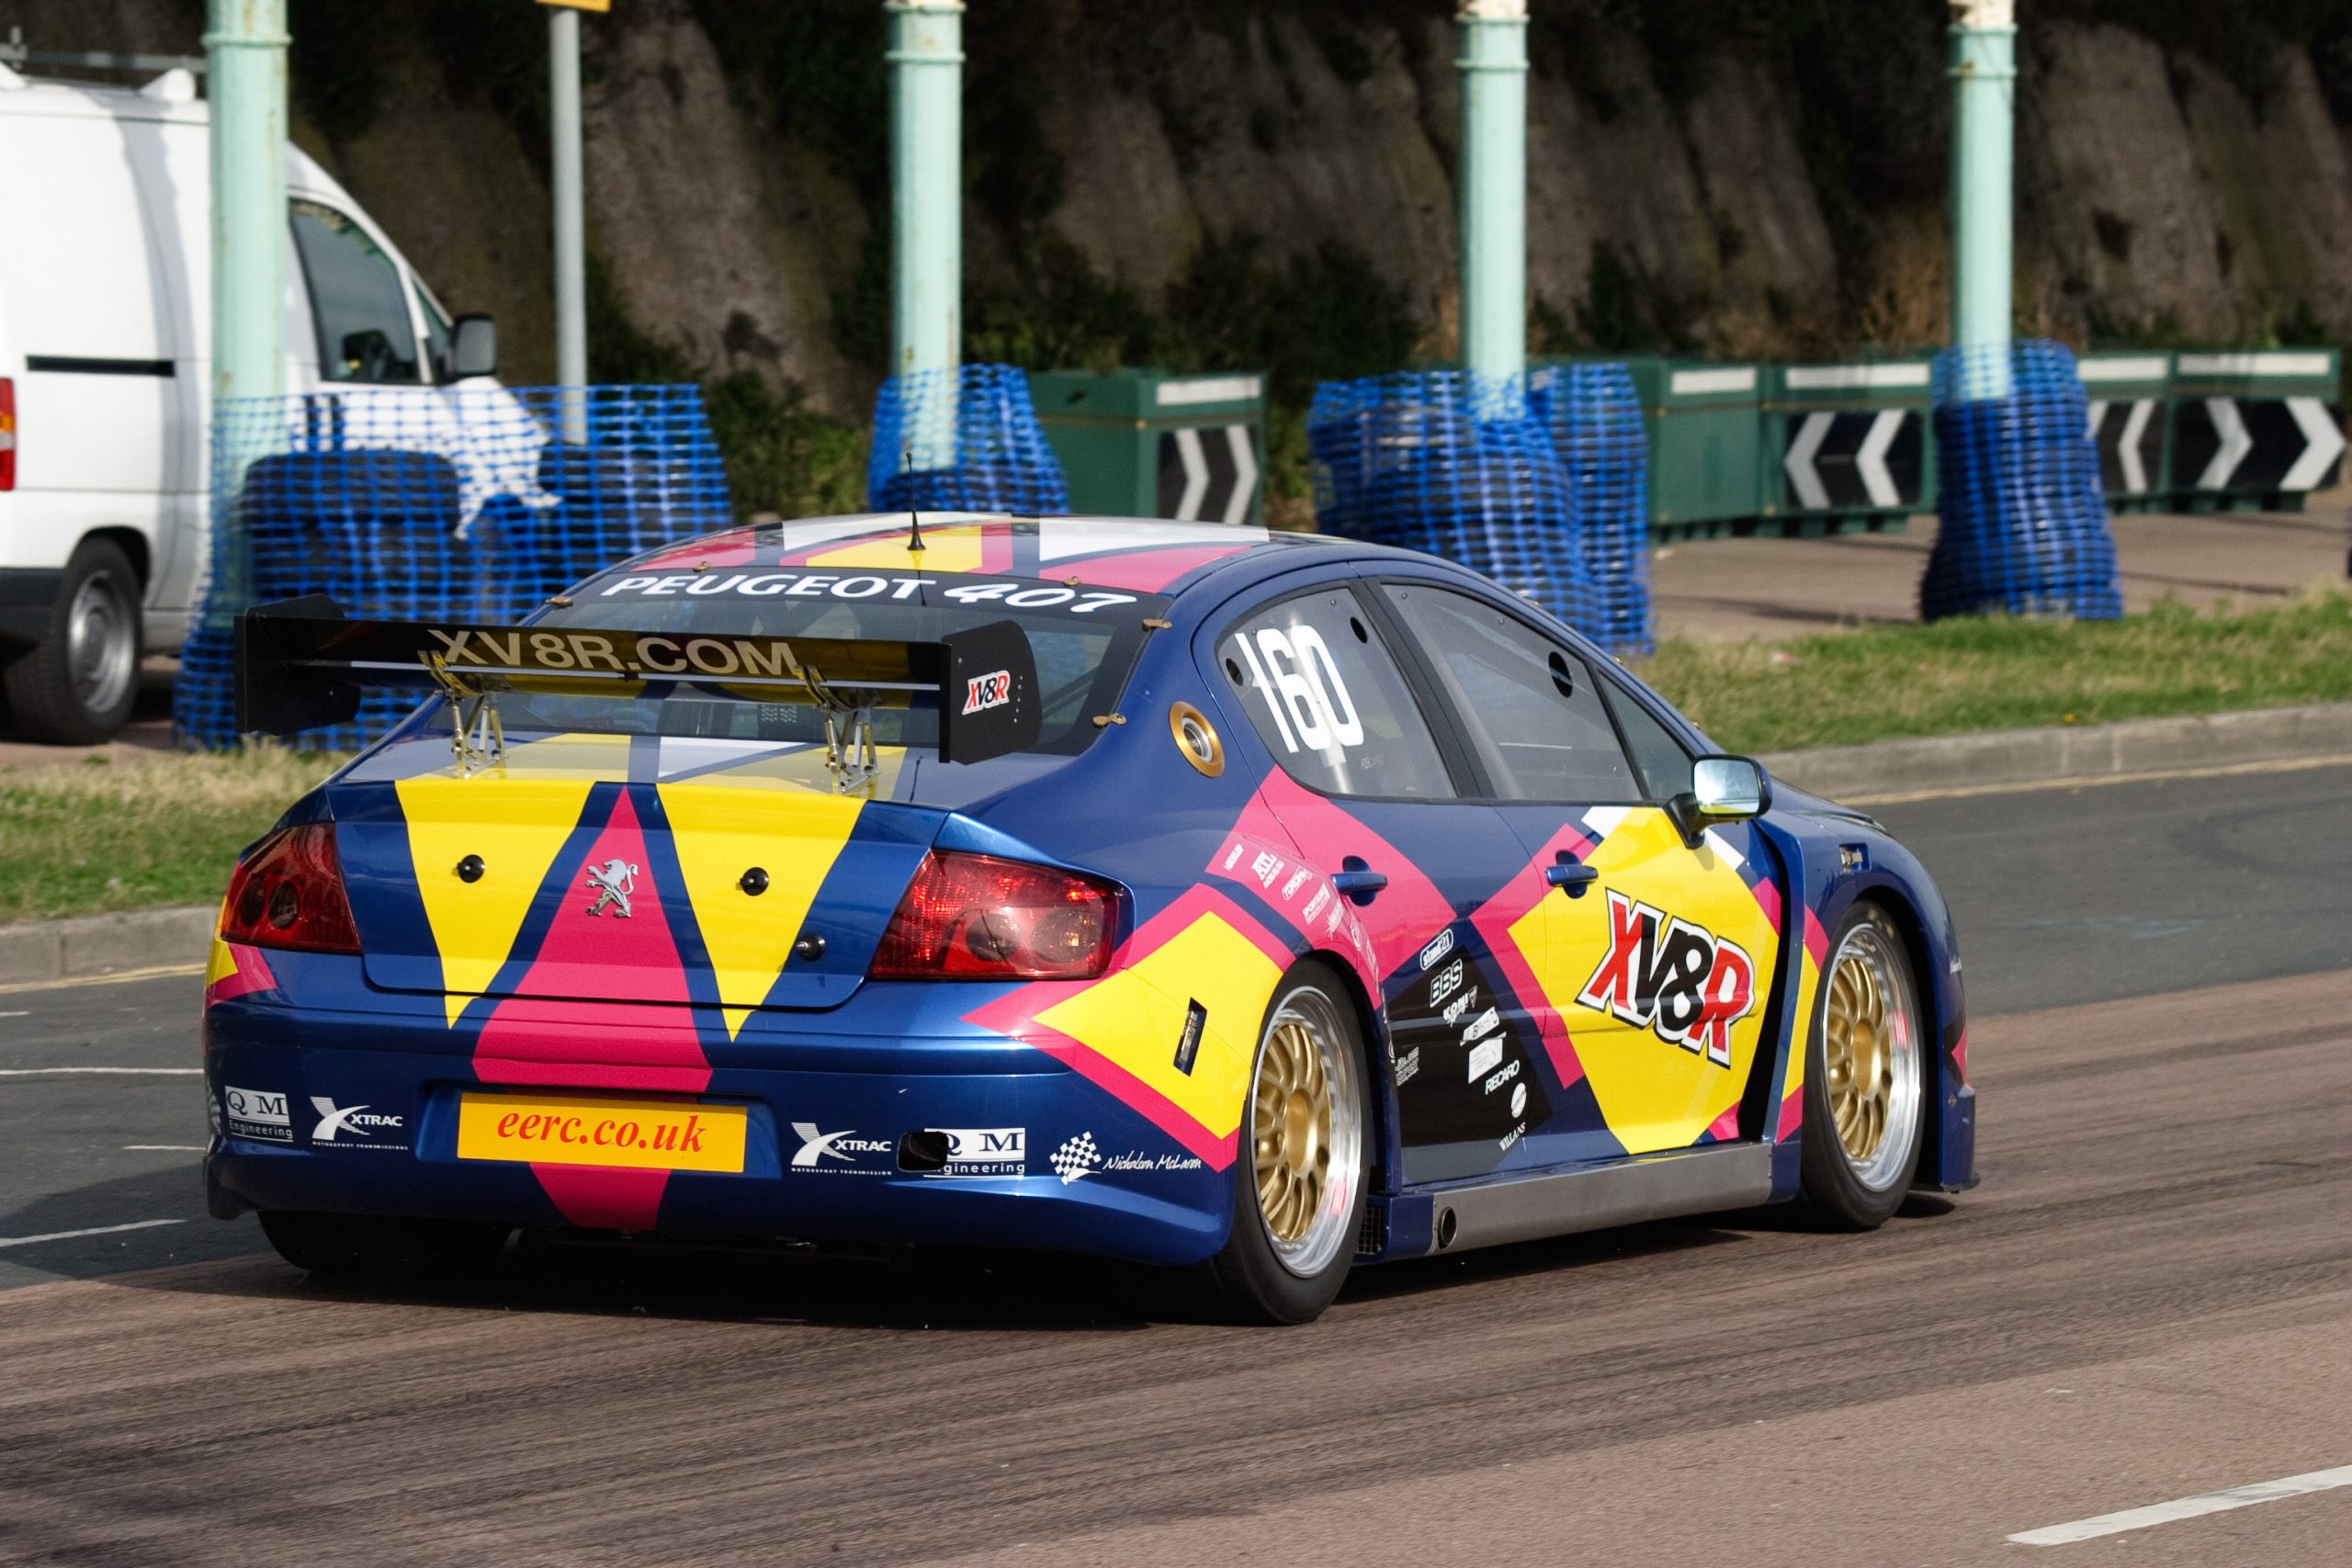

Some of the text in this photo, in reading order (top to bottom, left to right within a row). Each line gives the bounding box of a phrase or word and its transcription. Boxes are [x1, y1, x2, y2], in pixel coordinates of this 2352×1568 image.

[600, 572, 1137, 614] PEUGEOT 407
[427, 629, 800, 676] XV8R.COM
[965, 673, 1010, 712] XV8R
[1234, 625, 1364, 754] 160
[1430, 959, 1463, 1008] BBS
[1580, 893, 1753, 1063] XV8R
[1485, 1059, 1520, 1095] RECARO
[229, 1119, 293, 1140] Engineering
[350, 1114, 403, 1126] XTRAC
[497, 1112, 707, 1153] eerc.co.uk
[834, 1139, 892, 1152] XTRAC
[1102, 1149, 1154, 1170] Nicholson
[938, 1162, 1026, 1177] gineering
